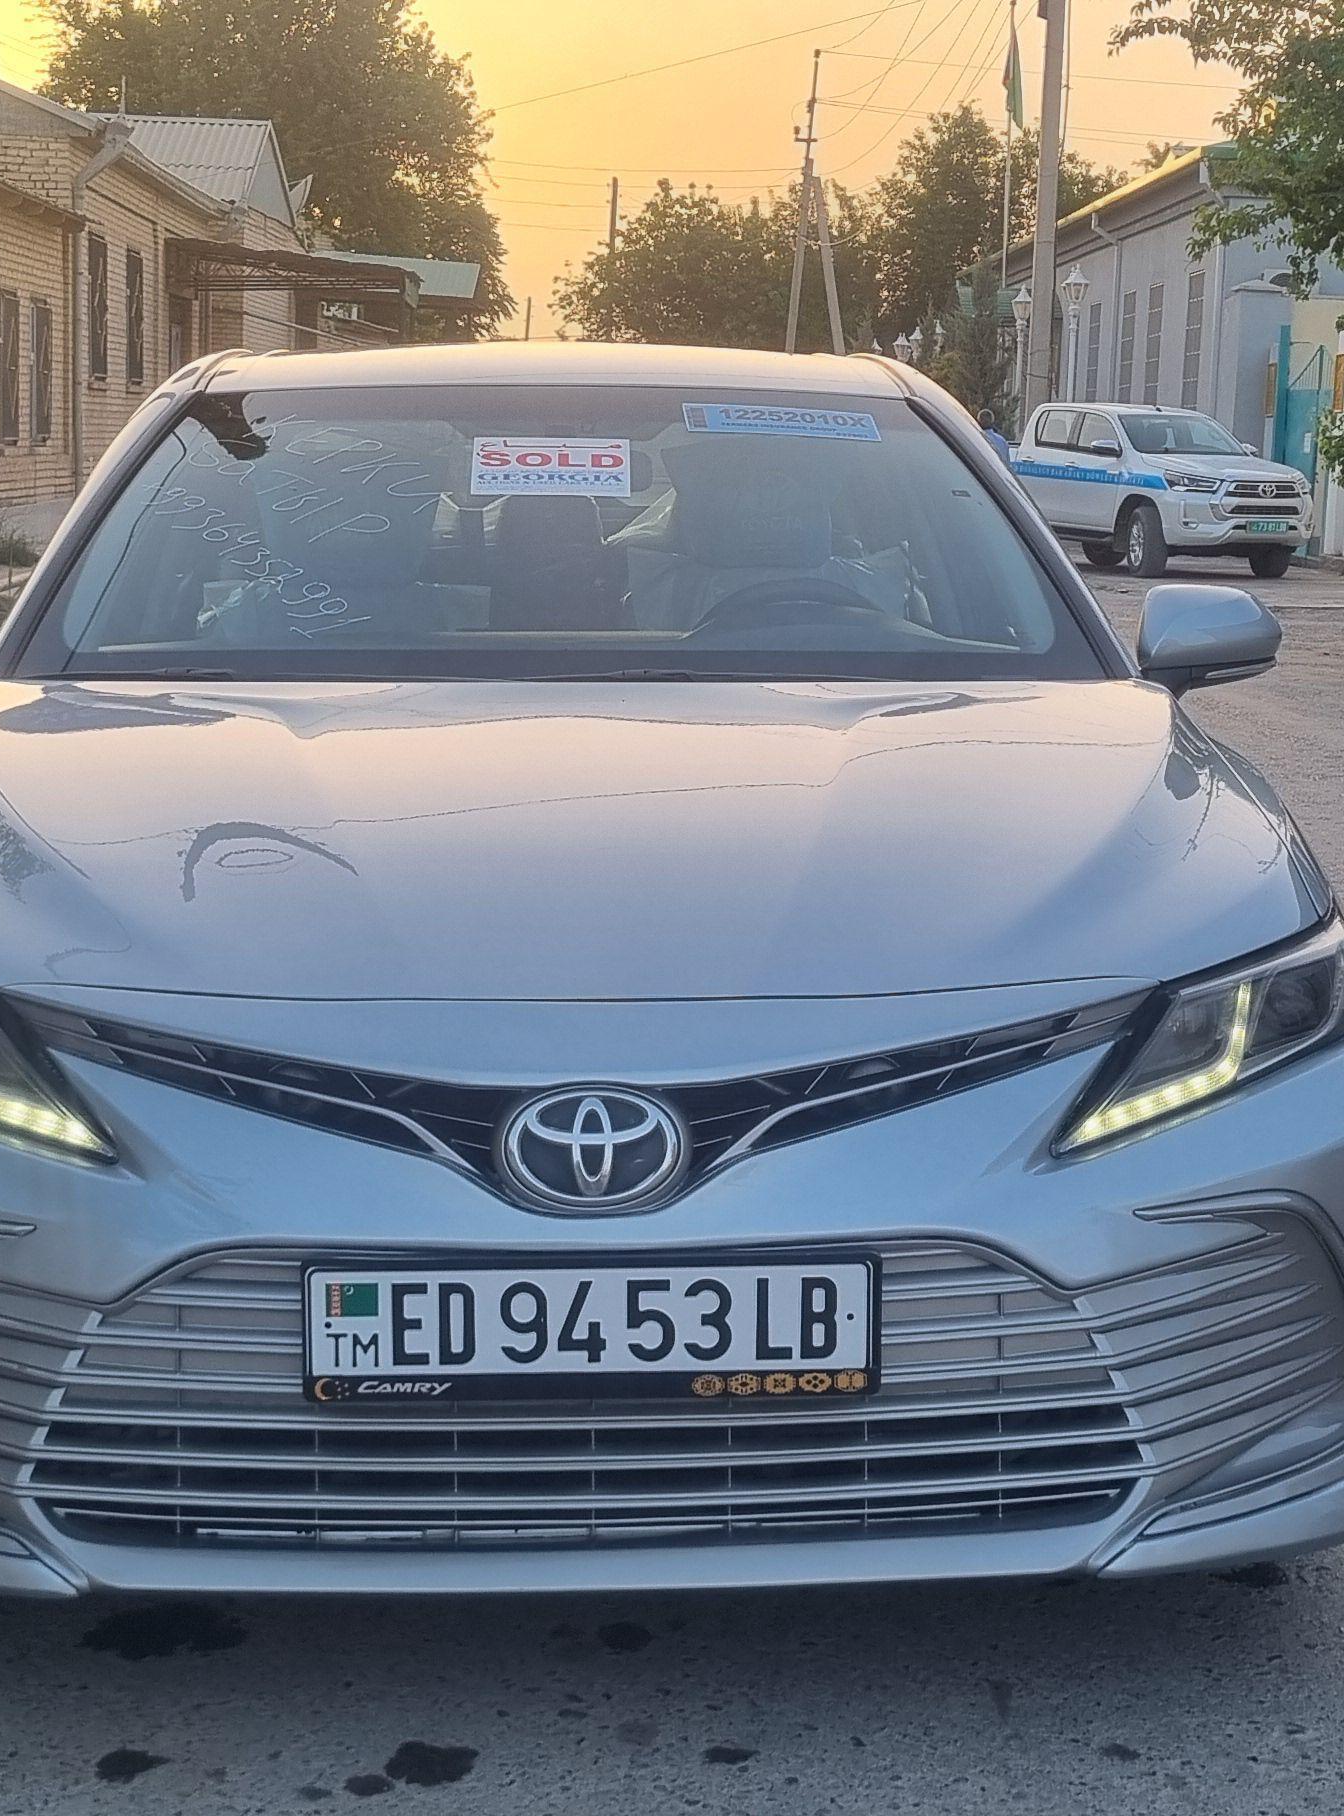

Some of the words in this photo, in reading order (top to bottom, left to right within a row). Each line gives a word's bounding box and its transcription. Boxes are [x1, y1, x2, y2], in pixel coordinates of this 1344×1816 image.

[718, 407, 869, 428] 12252010X
[479, 452, 624, 468] SOLD
[478, 473, 624, 482] GEORGIA
[326, 1332, 380, 1369] TM
[357, 1380, 453, 1396] CAMRY
